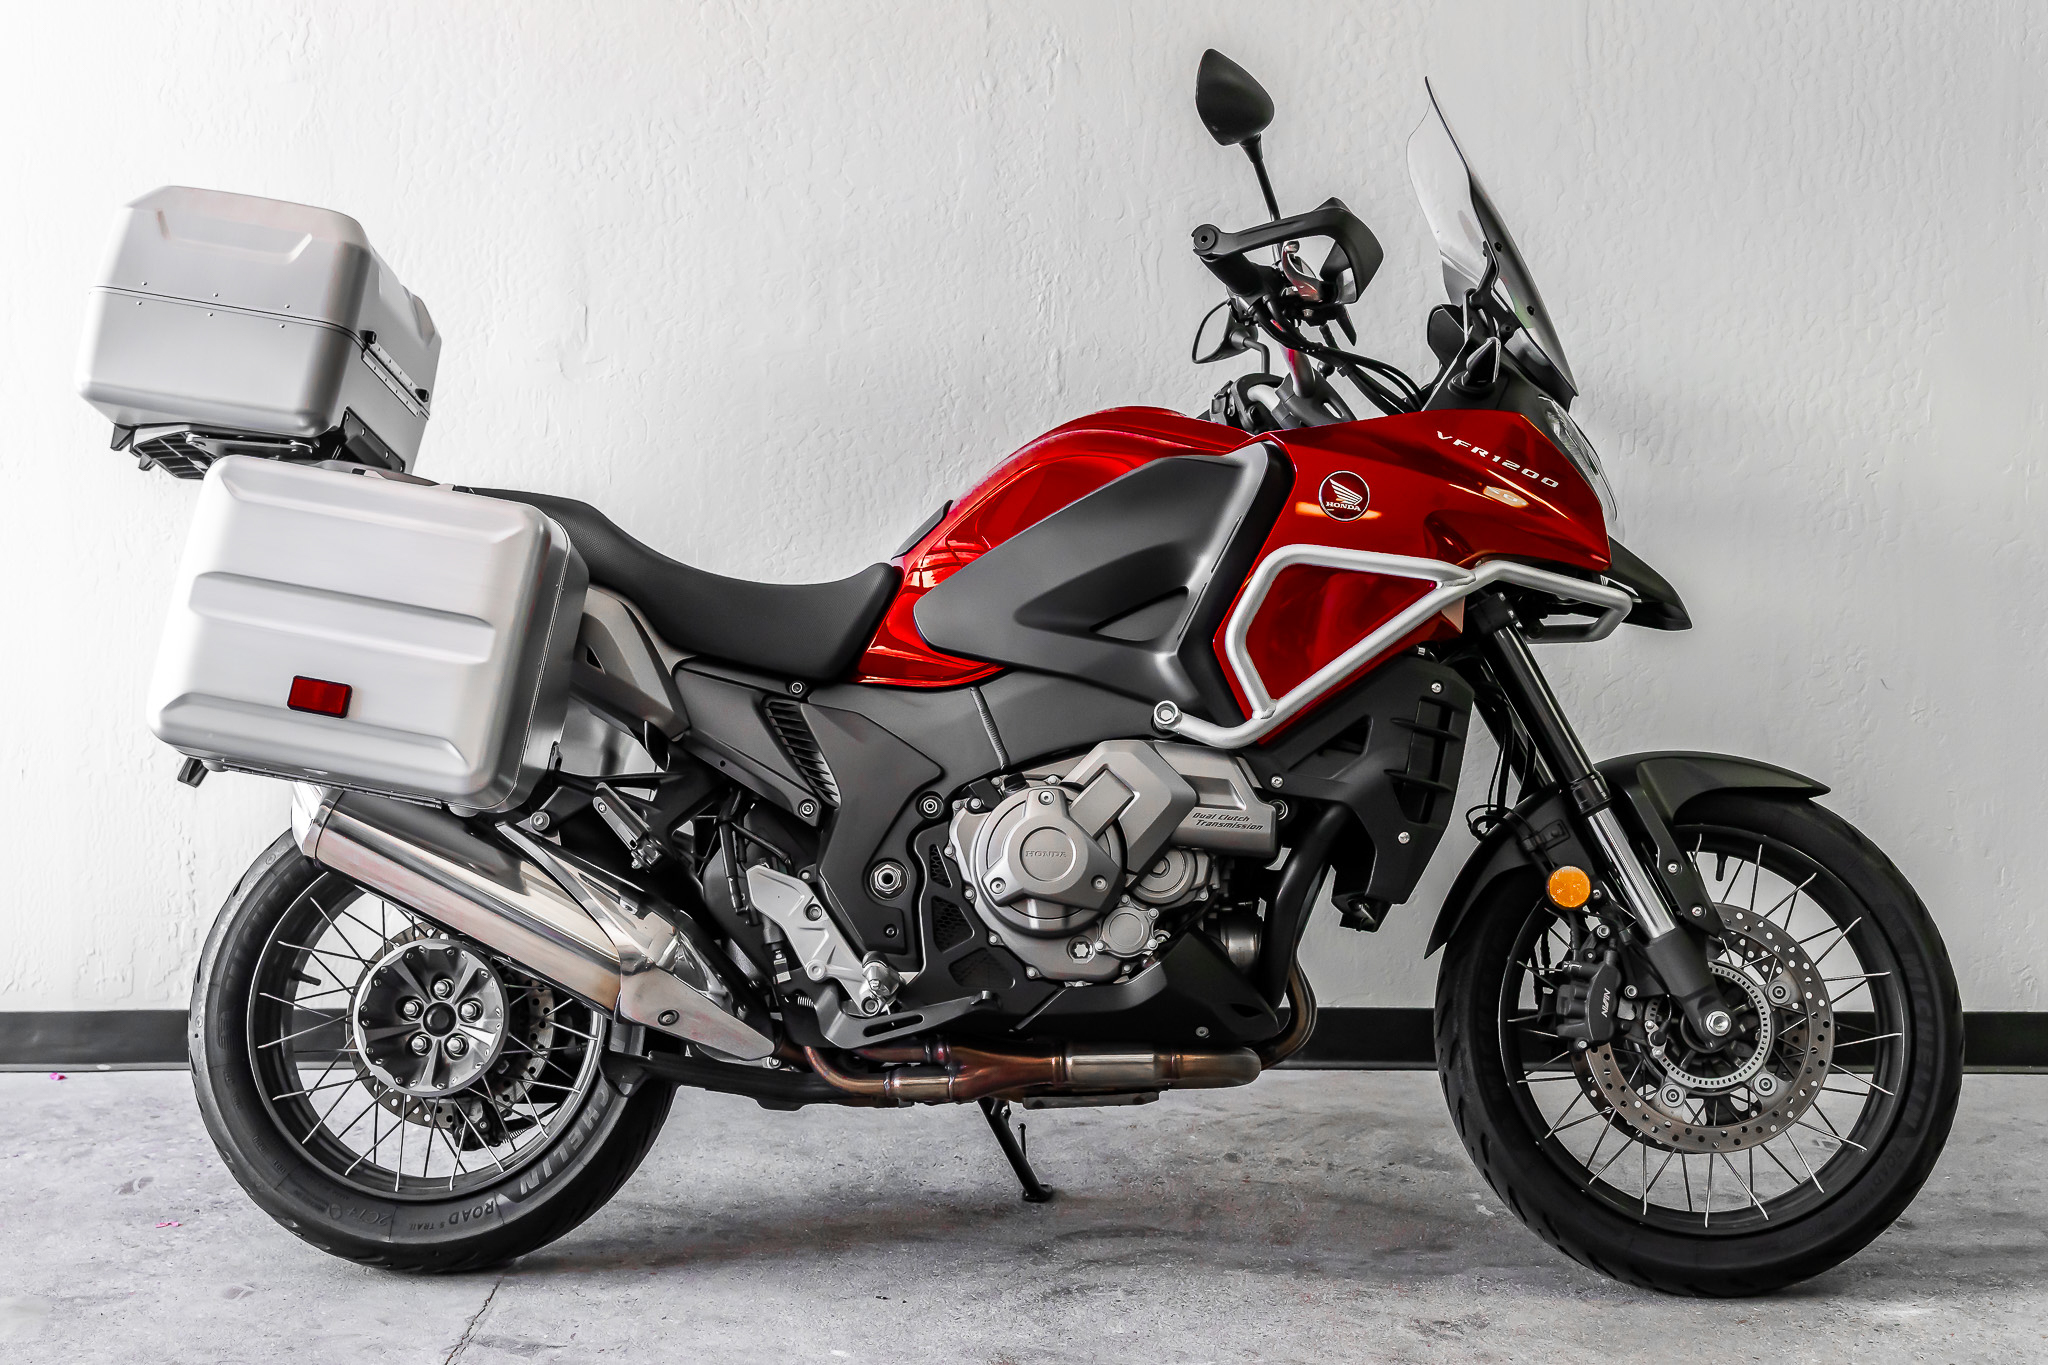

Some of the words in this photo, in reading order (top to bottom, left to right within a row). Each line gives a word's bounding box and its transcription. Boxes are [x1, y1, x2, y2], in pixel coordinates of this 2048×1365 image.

[1437, 431, 1559, 488] VFR1200
[1325, 501, 1361, 511] HONDA
[1192, 812, 1217, 820] Dual
[1218, 814, 1250, 822] Clutch
[1196, 819, 1264, 831] Transmission
[1025, 850, 1067, 858] HONDA
[448, 1201, 498, 1225] ROAD
